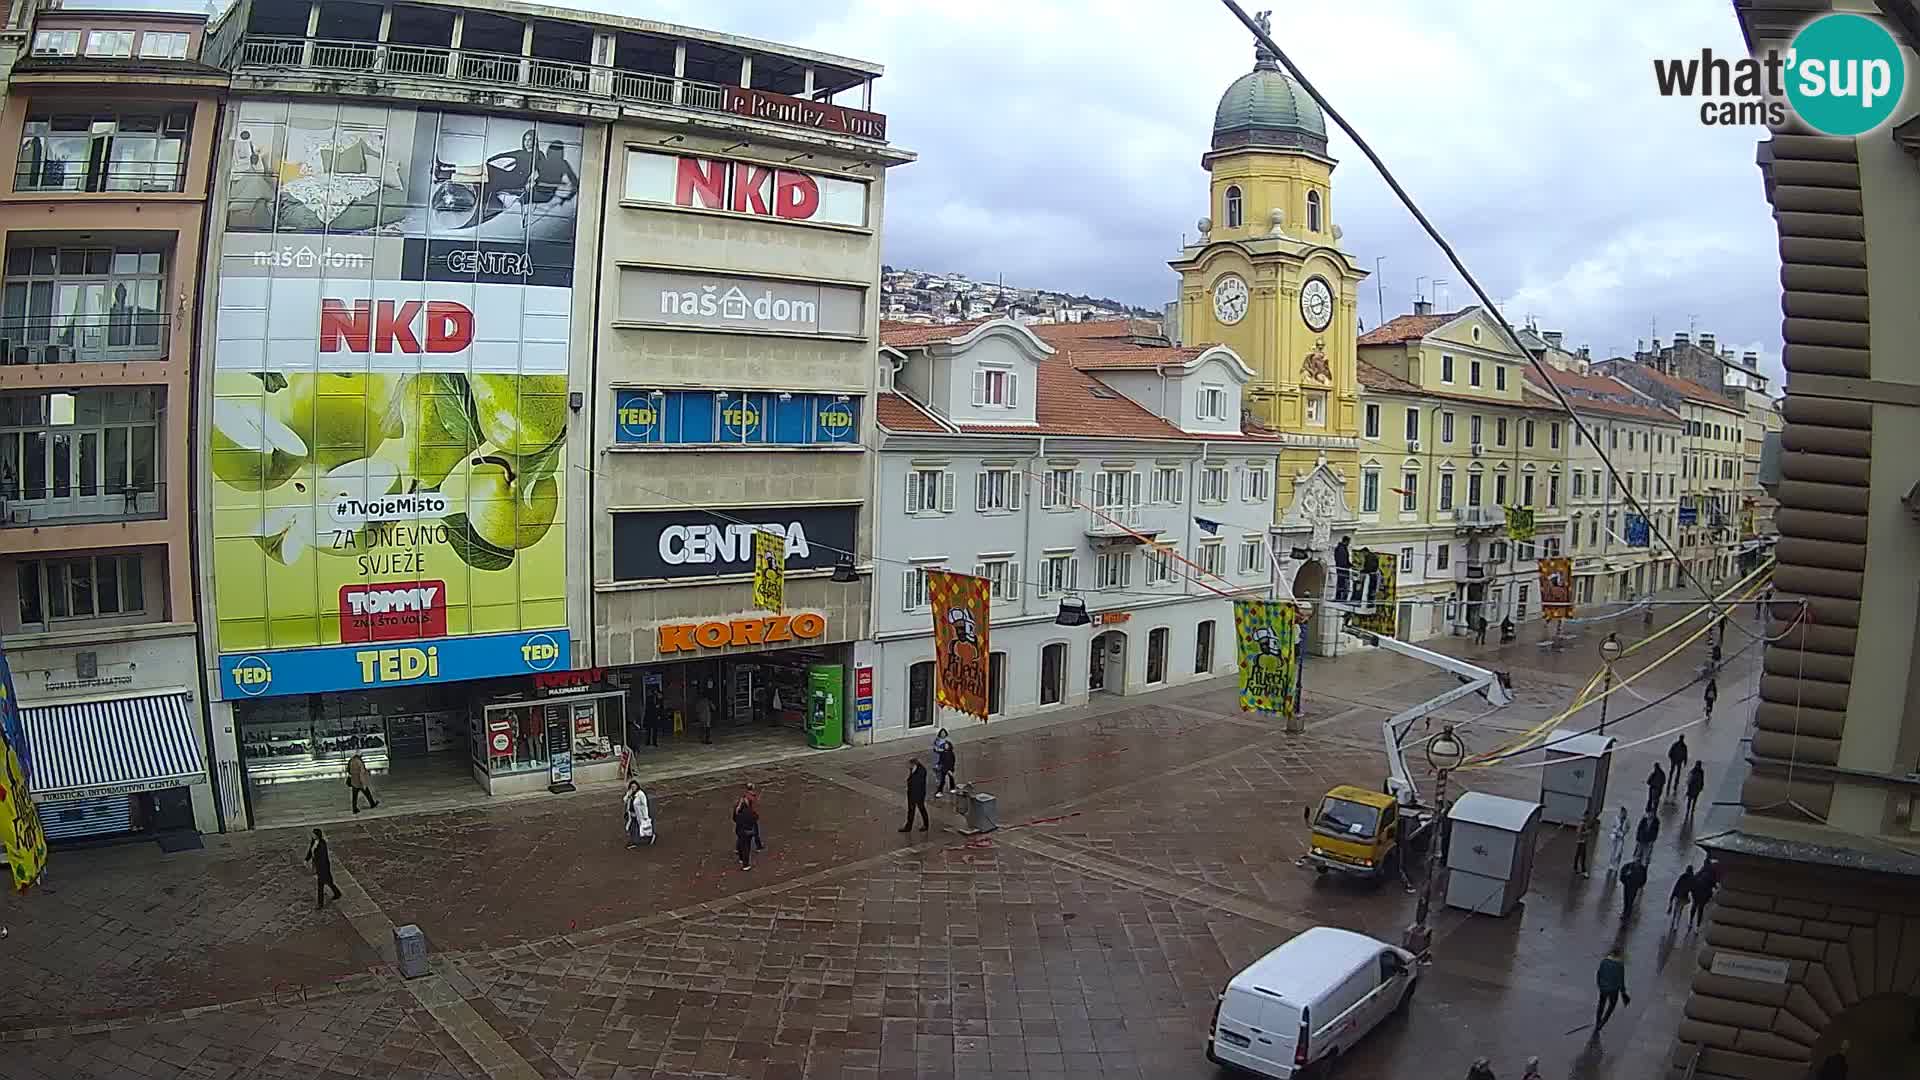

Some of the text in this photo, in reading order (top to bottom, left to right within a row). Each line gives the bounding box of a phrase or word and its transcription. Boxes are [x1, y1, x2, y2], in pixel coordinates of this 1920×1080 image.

[722, 88, 745, 112] Le
[675, 156, 820, 221] NKD
[253, 245, 364, 269] naš dom
[446, 250, 534, 276] CENTRA
[659, 285, 816, 323] naš dom
[319, 297, 476, 354] NKD
[618, 408, 657, 426] TEDi
[722, 409, 760, 426] TEDi
[819, 411, 853, 427] TEDi
[336, 497, 446, 517] #TvojeMisto
[332, 523, 450, 549] ZA DNEVNO
[358, 550, 426, 577] SVJEŽE
[347, 587, 439, 615] TOMMY
[658, 612, 826, 653] KORZO
[357, 645, 439, 684] TEDi
[520, 643, 560, 662] TEDi
[45, 676, 132, 692] TOURIST INFORMATION
[231, 666, 272, 685] TEDi
